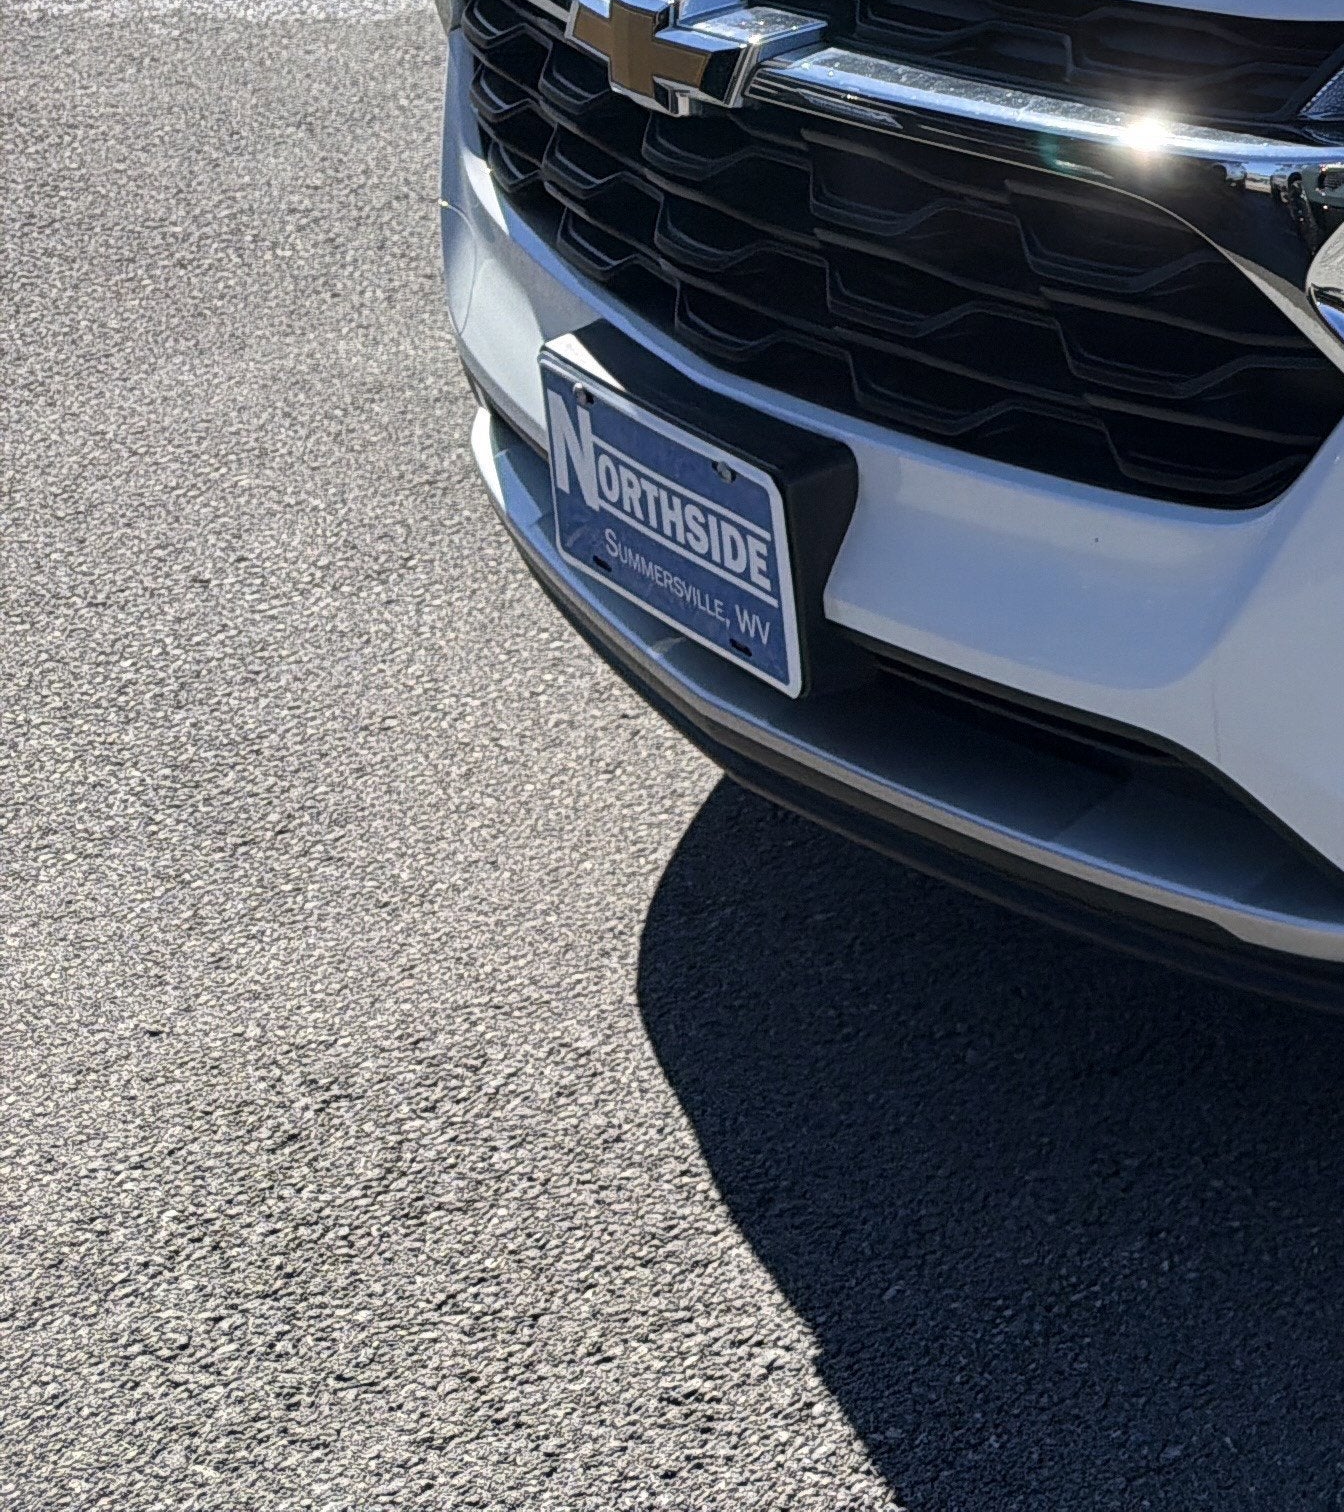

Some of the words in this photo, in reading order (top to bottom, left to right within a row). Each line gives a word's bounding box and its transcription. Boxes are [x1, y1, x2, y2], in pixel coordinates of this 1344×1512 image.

[546, 388, 773, 592] NORTHSIDE
[604, 527, 731, 630] SUMMERSVILLE,
[735, 603, 771, 646] WV
